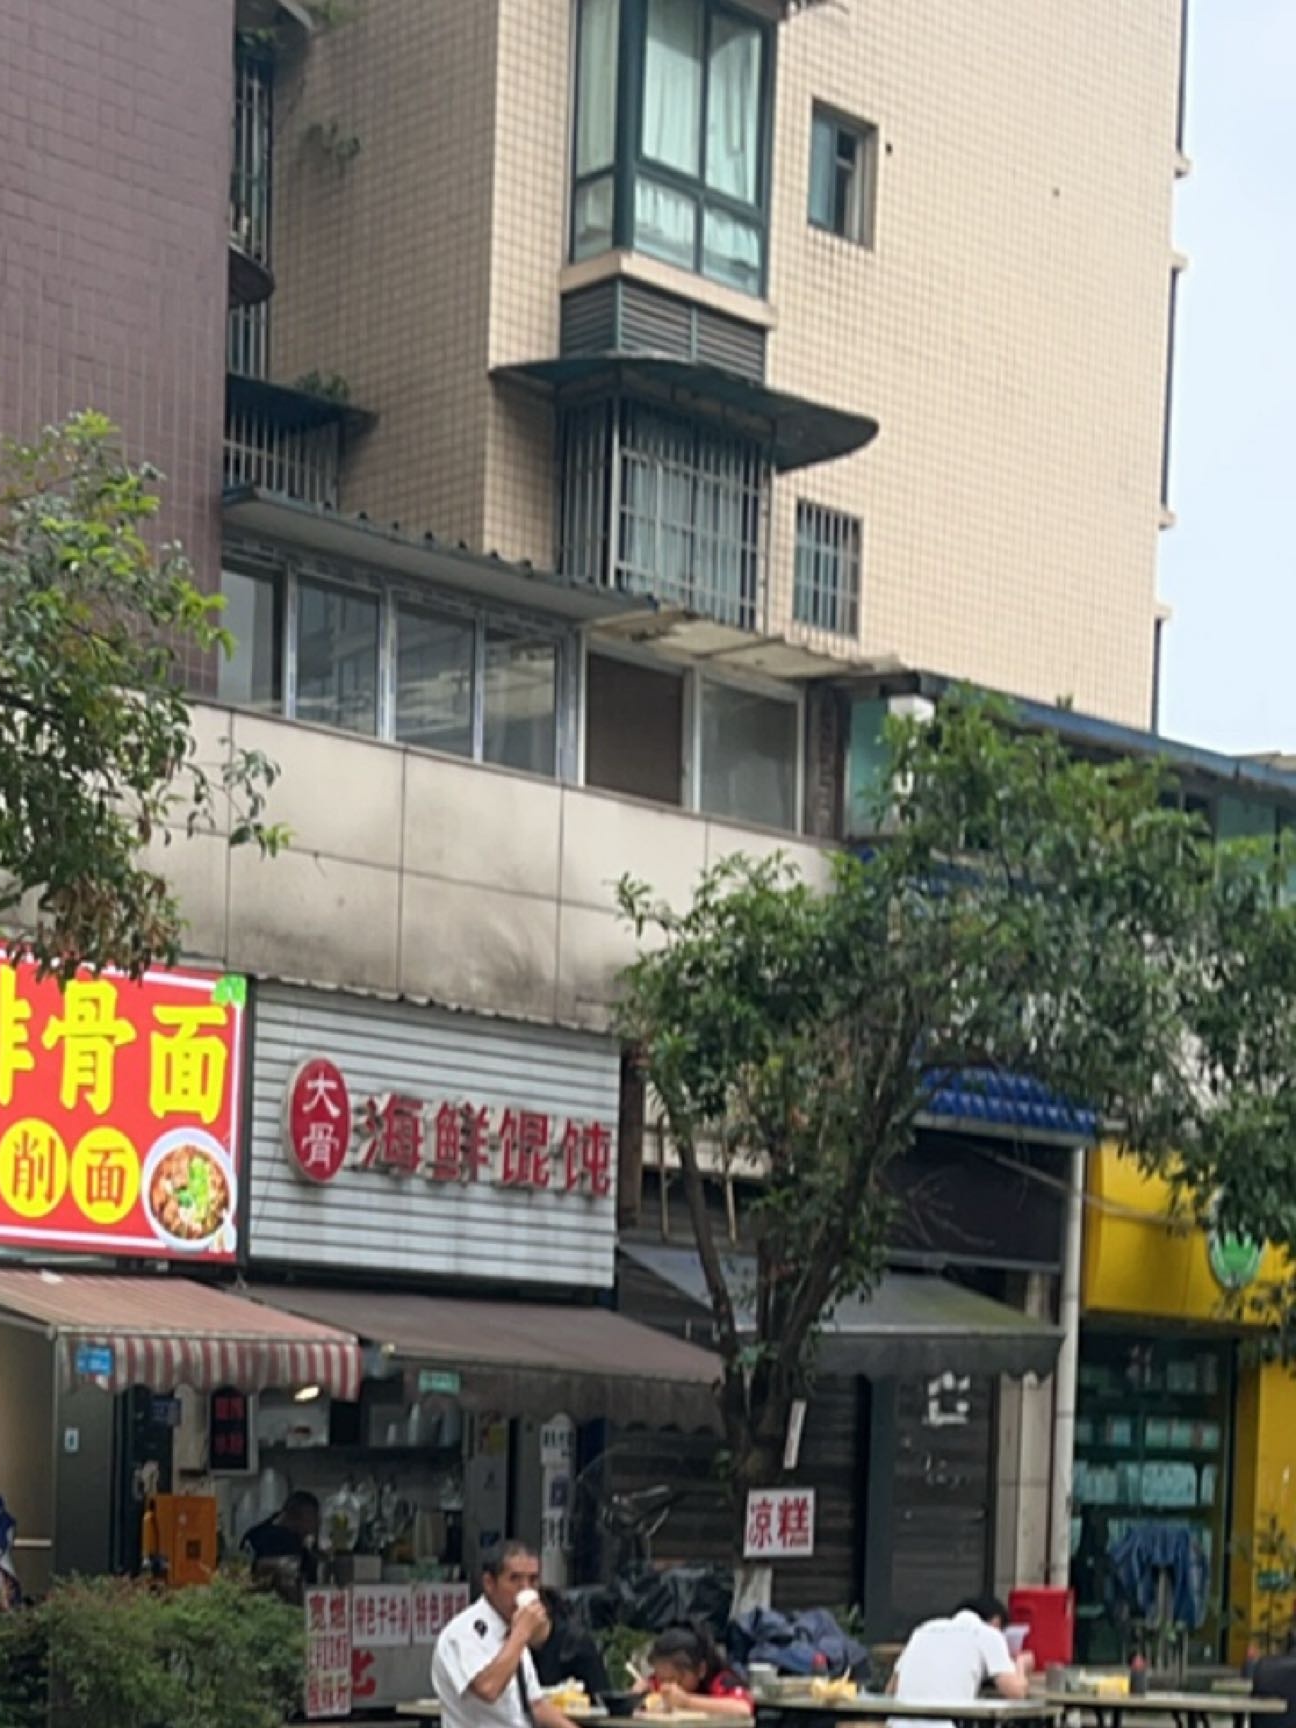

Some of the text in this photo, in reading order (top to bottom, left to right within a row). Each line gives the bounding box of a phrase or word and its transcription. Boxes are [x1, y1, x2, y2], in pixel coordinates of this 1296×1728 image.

[301, 1071, 341, 1171] 大骨
[360, 1092, 613, 1197] 海鲜馄饨
